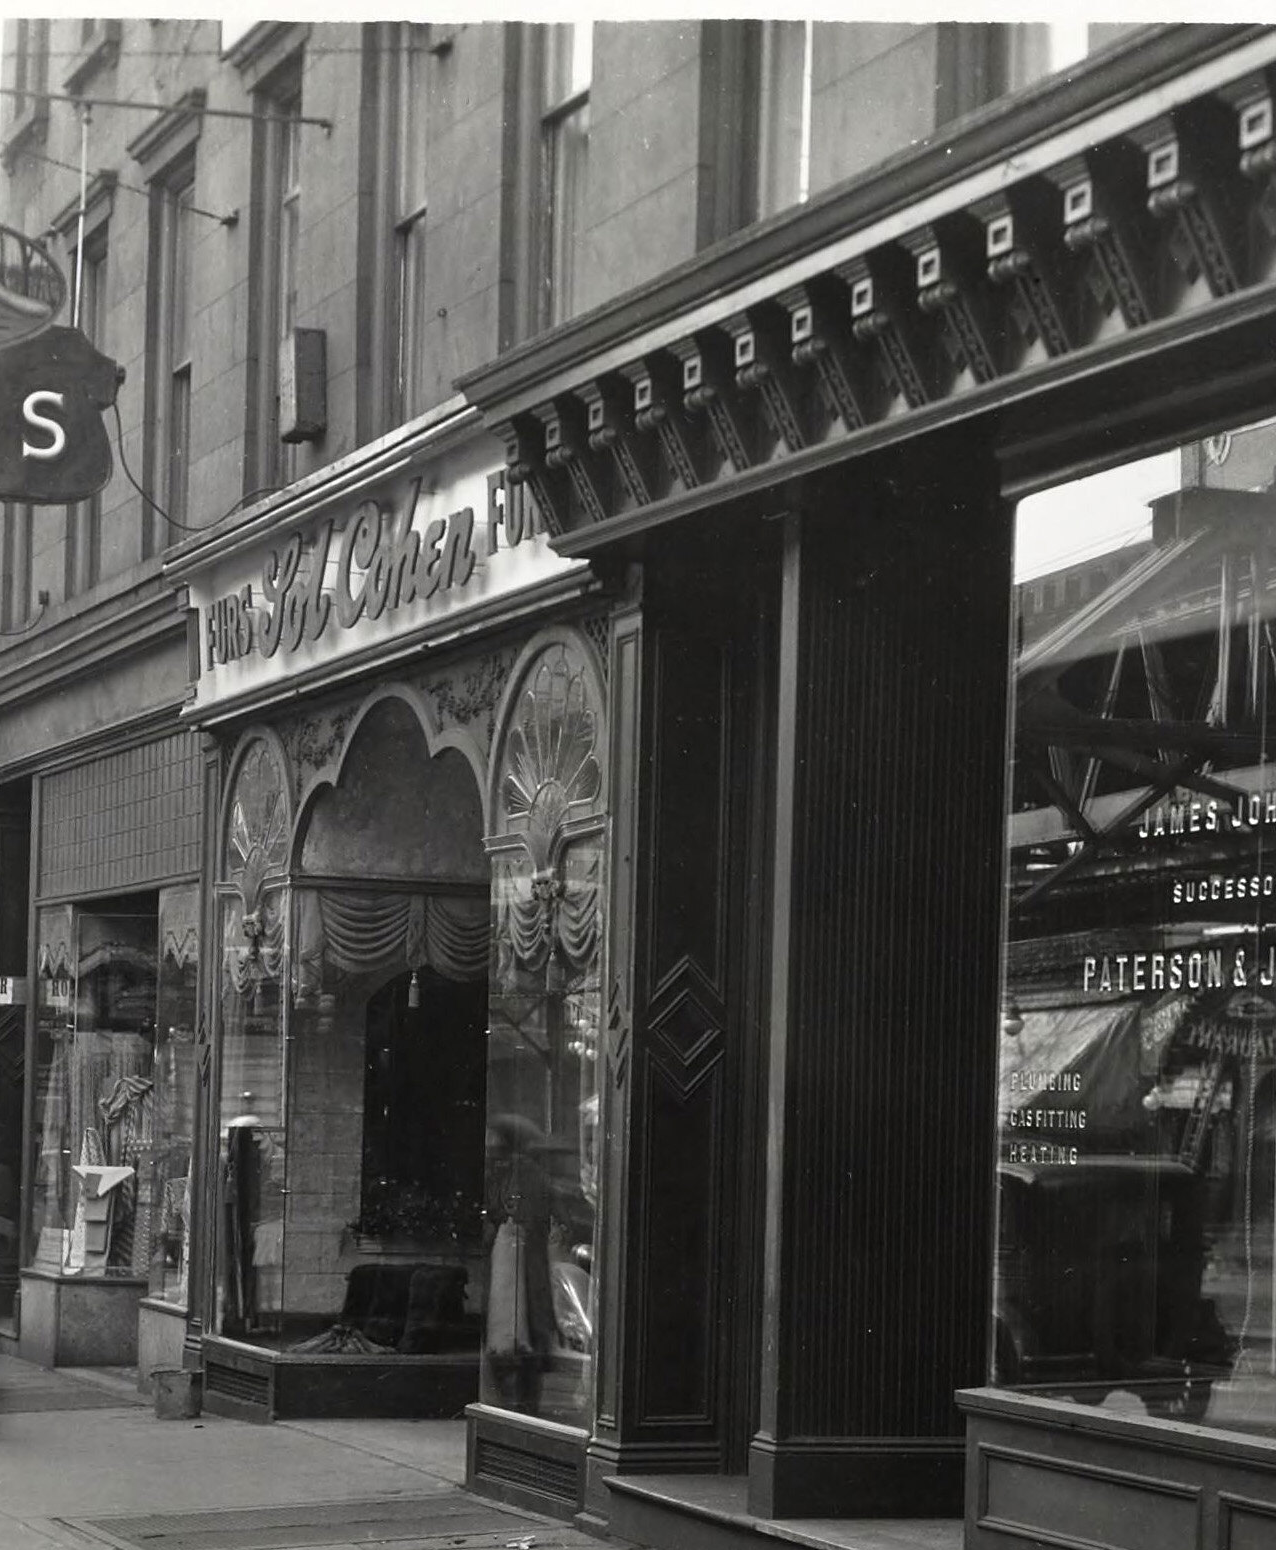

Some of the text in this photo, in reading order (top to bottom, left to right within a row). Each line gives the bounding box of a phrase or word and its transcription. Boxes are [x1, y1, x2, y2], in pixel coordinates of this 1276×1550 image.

[206, 584, 253, 671] FURS
[257, 517, 335, 659] Sol
[335, 477, 476, 629] Cohen
[1139, 801, 1219, 838] JAMES
[1082, 949, 1223, 992] PATERSON
[1232, 948, 1248, 987] &
[1010, 1072, 1082, 1092] PLUMBING
[1009, 1143, 1079, 1166] HEATING
